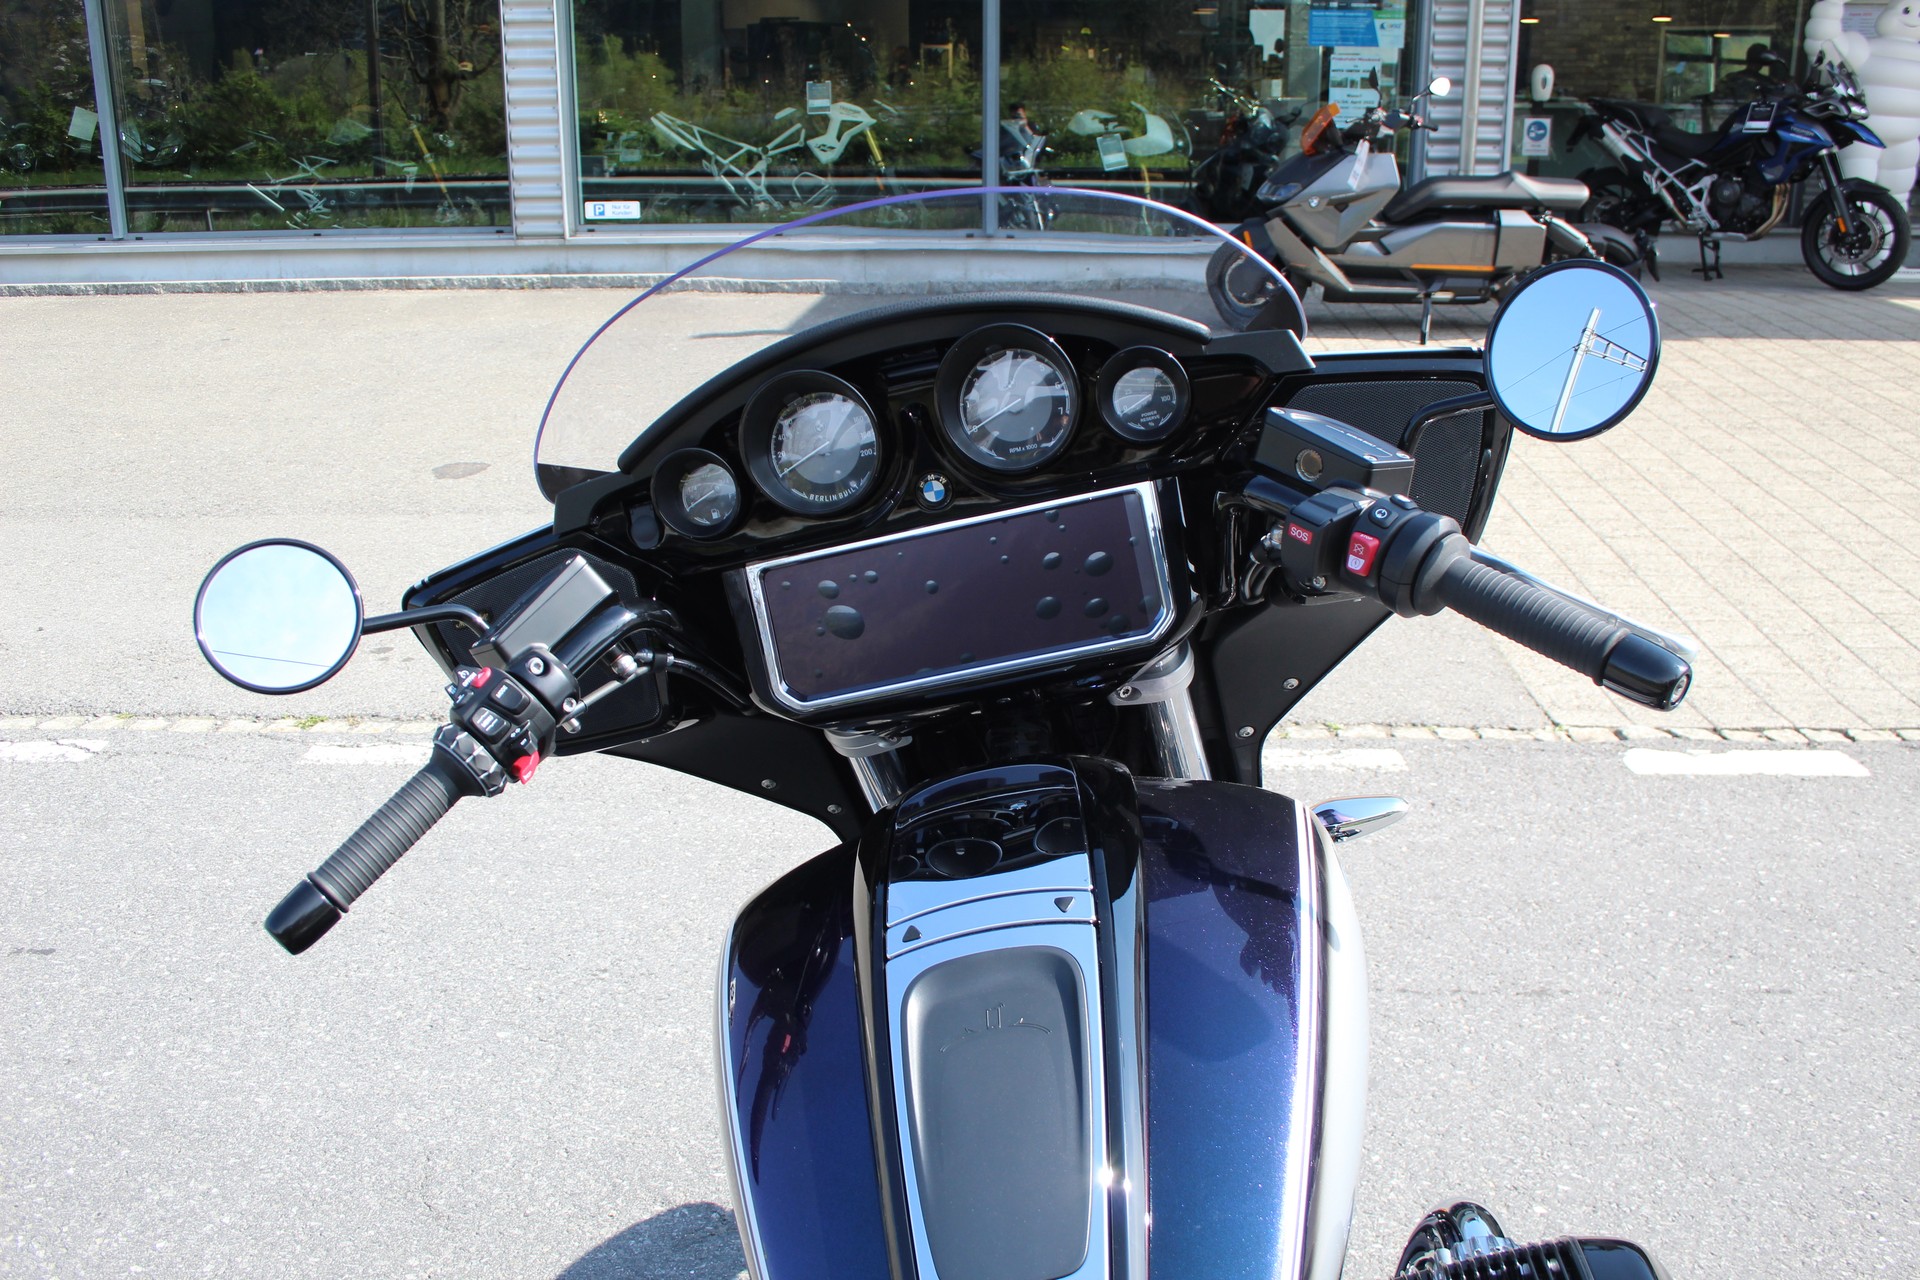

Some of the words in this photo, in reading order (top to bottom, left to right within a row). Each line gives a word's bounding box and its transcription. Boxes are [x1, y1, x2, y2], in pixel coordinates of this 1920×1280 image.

[1140, 414, 1160, 423] RESERVE
[1141, 410, 1157, 418] POWER
[860, 449, 873, 457] 200
[809, 493, 838, 502] BERLIN
[838, 484, 859, 499] BUILT
[1290, 526, 1309, 542] SOS
